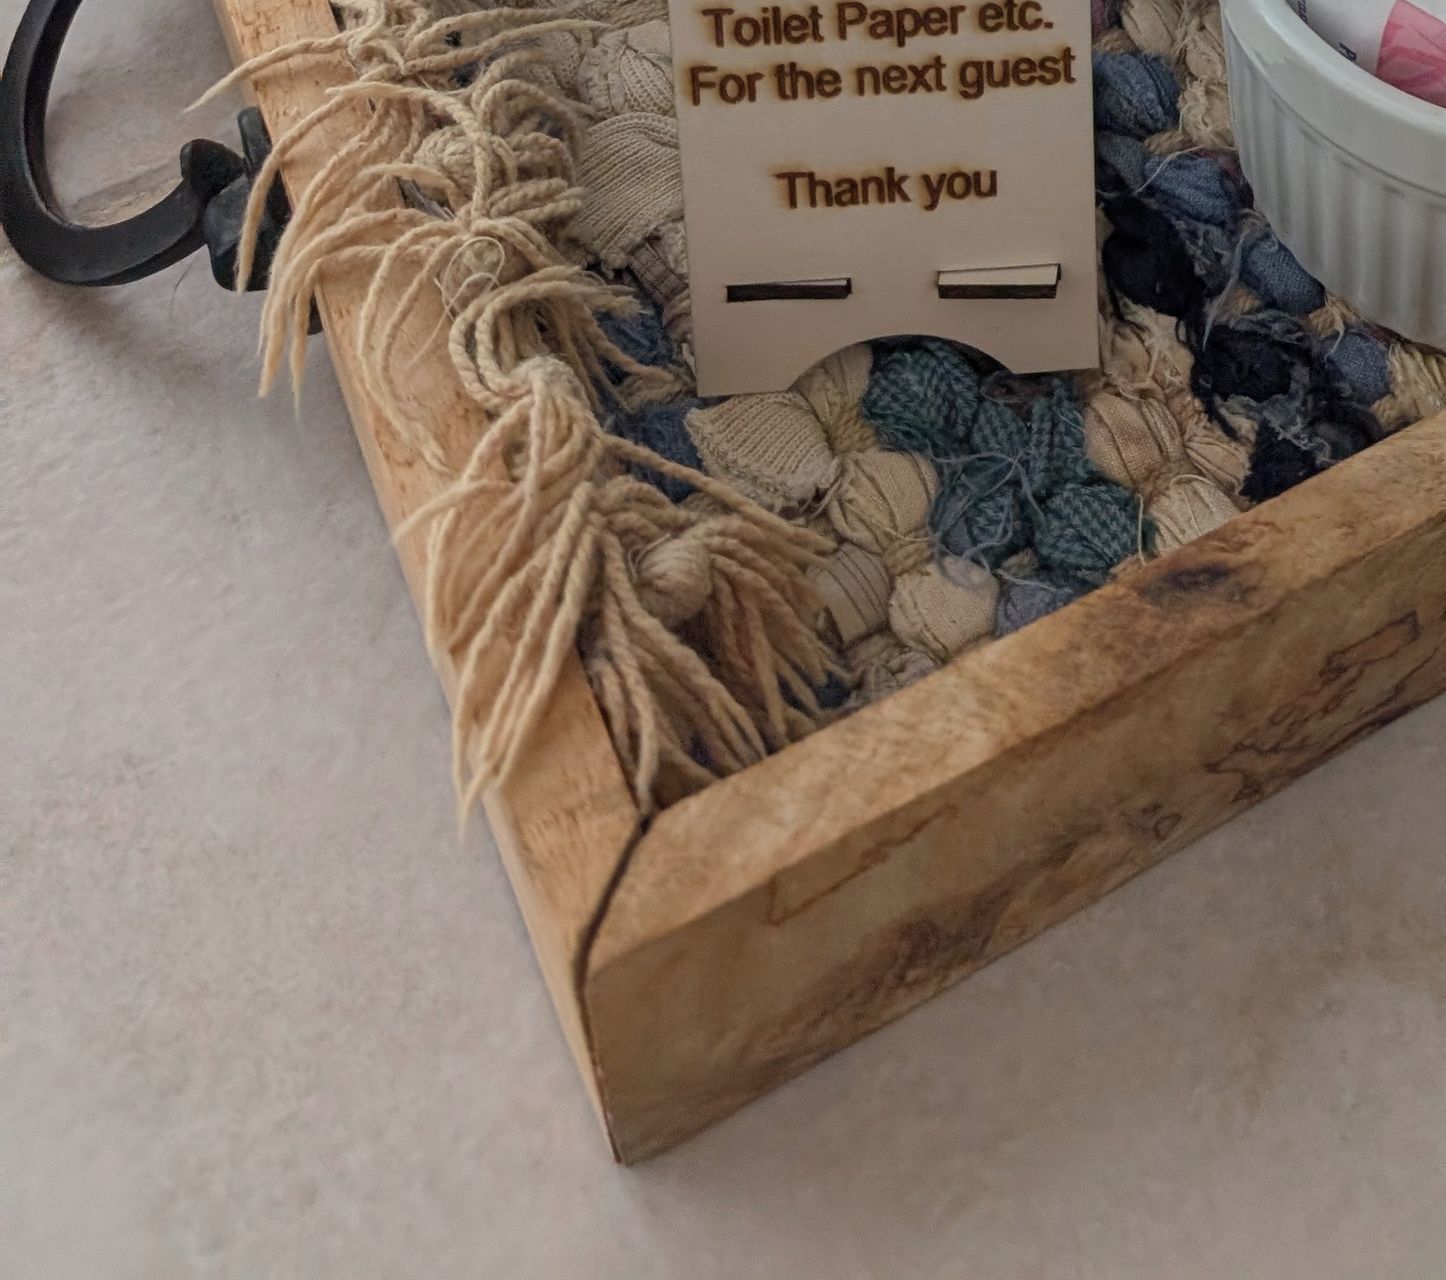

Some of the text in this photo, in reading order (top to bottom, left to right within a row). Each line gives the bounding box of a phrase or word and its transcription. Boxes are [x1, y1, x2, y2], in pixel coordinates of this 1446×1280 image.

[702, 5, 825, 48] Toilet
[836, 0, 965, 47] Paper
[689, 47, 1077, 106] For the next guest
[777, 166, 998, 212] Thank you
